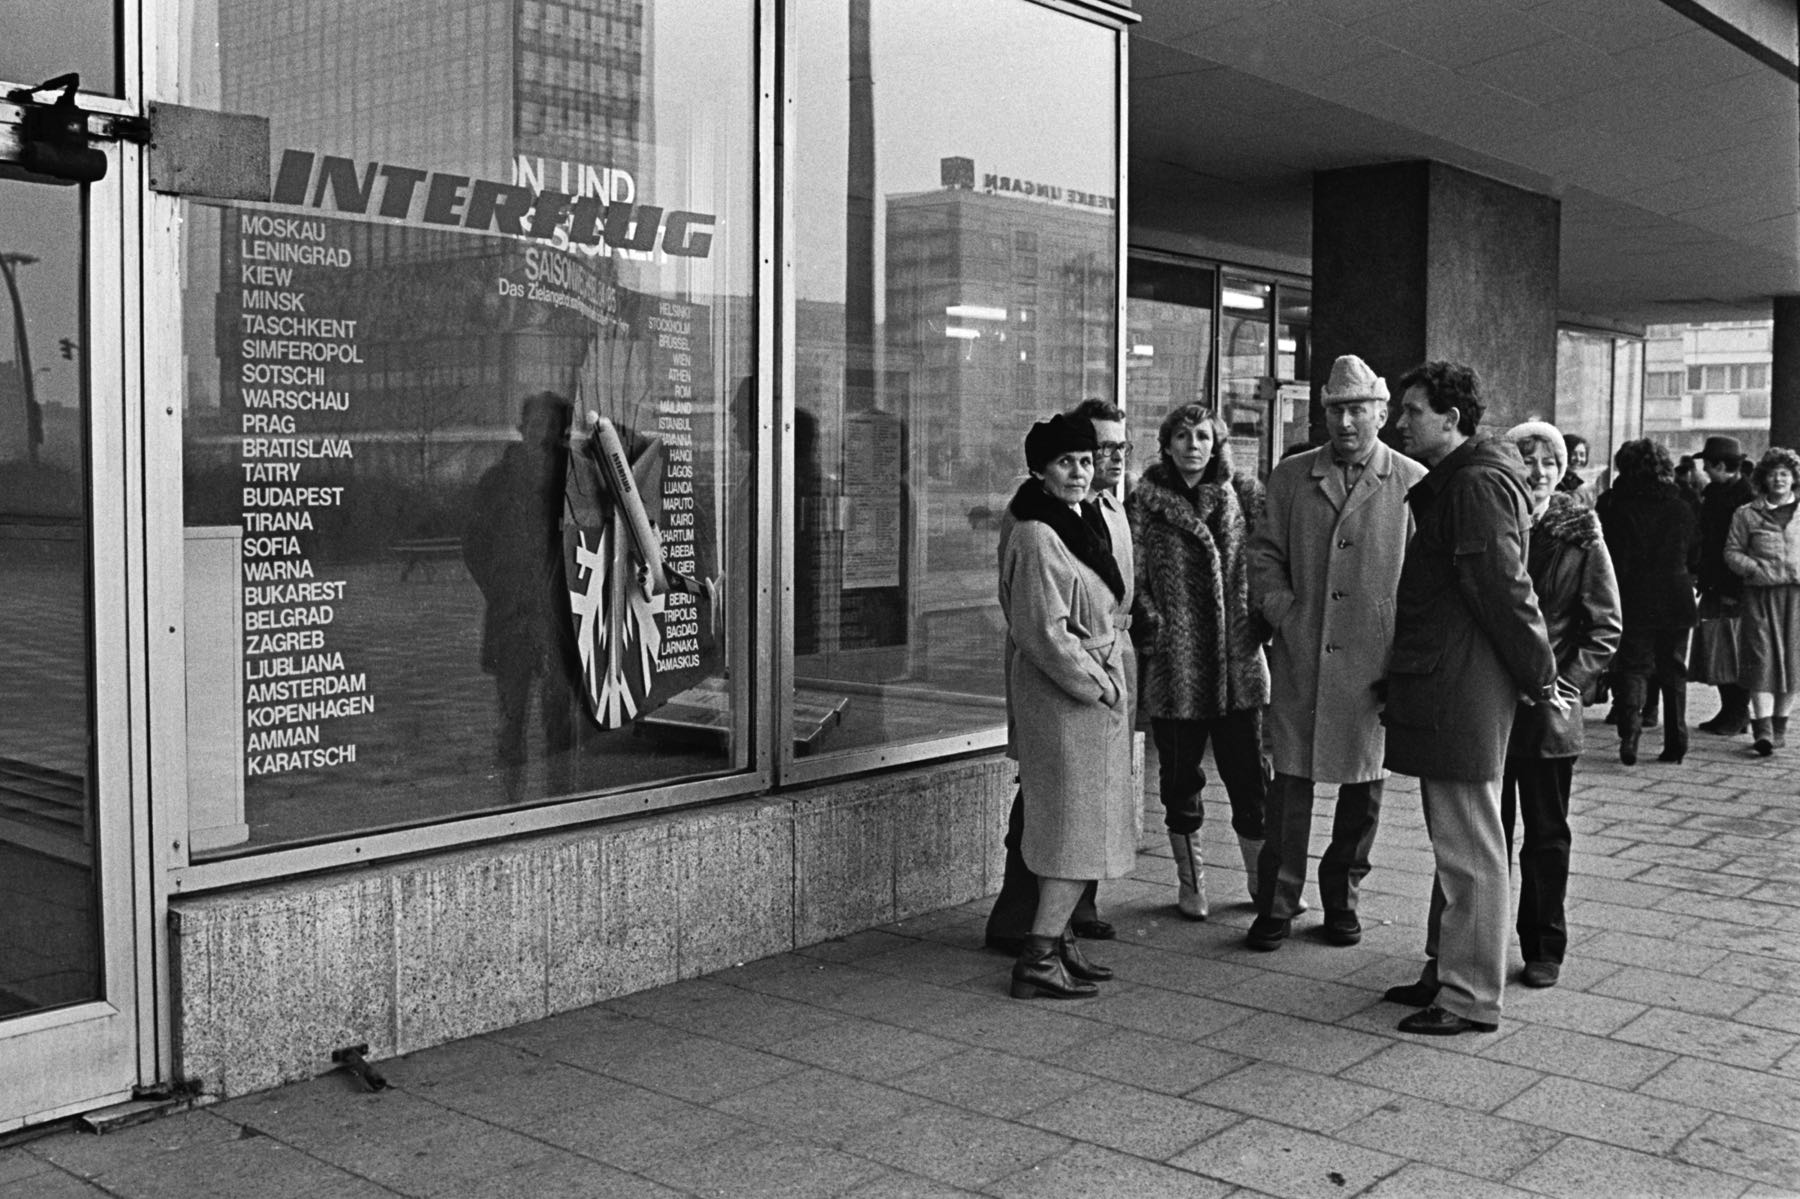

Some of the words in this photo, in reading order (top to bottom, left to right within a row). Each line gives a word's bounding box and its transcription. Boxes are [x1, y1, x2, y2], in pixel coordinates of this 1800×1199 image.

[272, 148, 716, 258] INTERFLUG
[242, 215, 325, 241] MOSKAU
[242, 239, 351, 267] LENINGRAD
[242, 265, 292, 286] KIEW
[499, 278, 525, 297] Das
[242, 290, 305, 312] MINSK
[242, 314, 357, 338] TASCHKENT
[648, 316, 691, 335] STOCKHOLM
[242, 339, 364, 363] SIMFEROPOL
[242, 364, 325, 386] SOTSCHI
[668, 367, 691, 383] ATHEN
[242, 388, 349, 410] WARSCHAU
[674, 384, 692, 399] ROM
[660, 400, 692, 414] MAILAND
[242, 414, 296, 434] PRAG
[242, 438, 353, 458] BRATISLAVA
[669, 449, 693, 462] HANOI
[242, 462, 301, 482] TATRY
[667, 465, 693, 478] LAGOS
[243, 487, 344, 506] BUDAPEST
[664, 481, 694, 494] LUANDA
[663, 497, 694, 510] MAPUTO
[242, 511, 314, 531] TIRANA
[670, 512, 694, 527] KAIRO
[244, 536, 301, 557] SOFIA
[669, 544, 696, 558] ABEBA
[244, 559, 314, 582] WARNA
[245, 581, 347, 606] BUKAREST
[245, 605, 334, 631] BELGRAD
[663, 607, 697, 623] TRIPOLIS
[666, 622, 698, 639] BAGDAD
[246, 630, 325, 655] ZAGREB
[661, 638, 699, 656] LARNAKA
[246, 652, 345, 680] LJUBLJANA
[656, 654, 700, 672] DAMASKUS
[246, 673, 366, 704] AMSTERDAM
[248, 695, 375, 728] KOPENHAGEN
[247, 725, 320, 752] AMMAN
[248, 744, 356, 776] KARATSCHI
